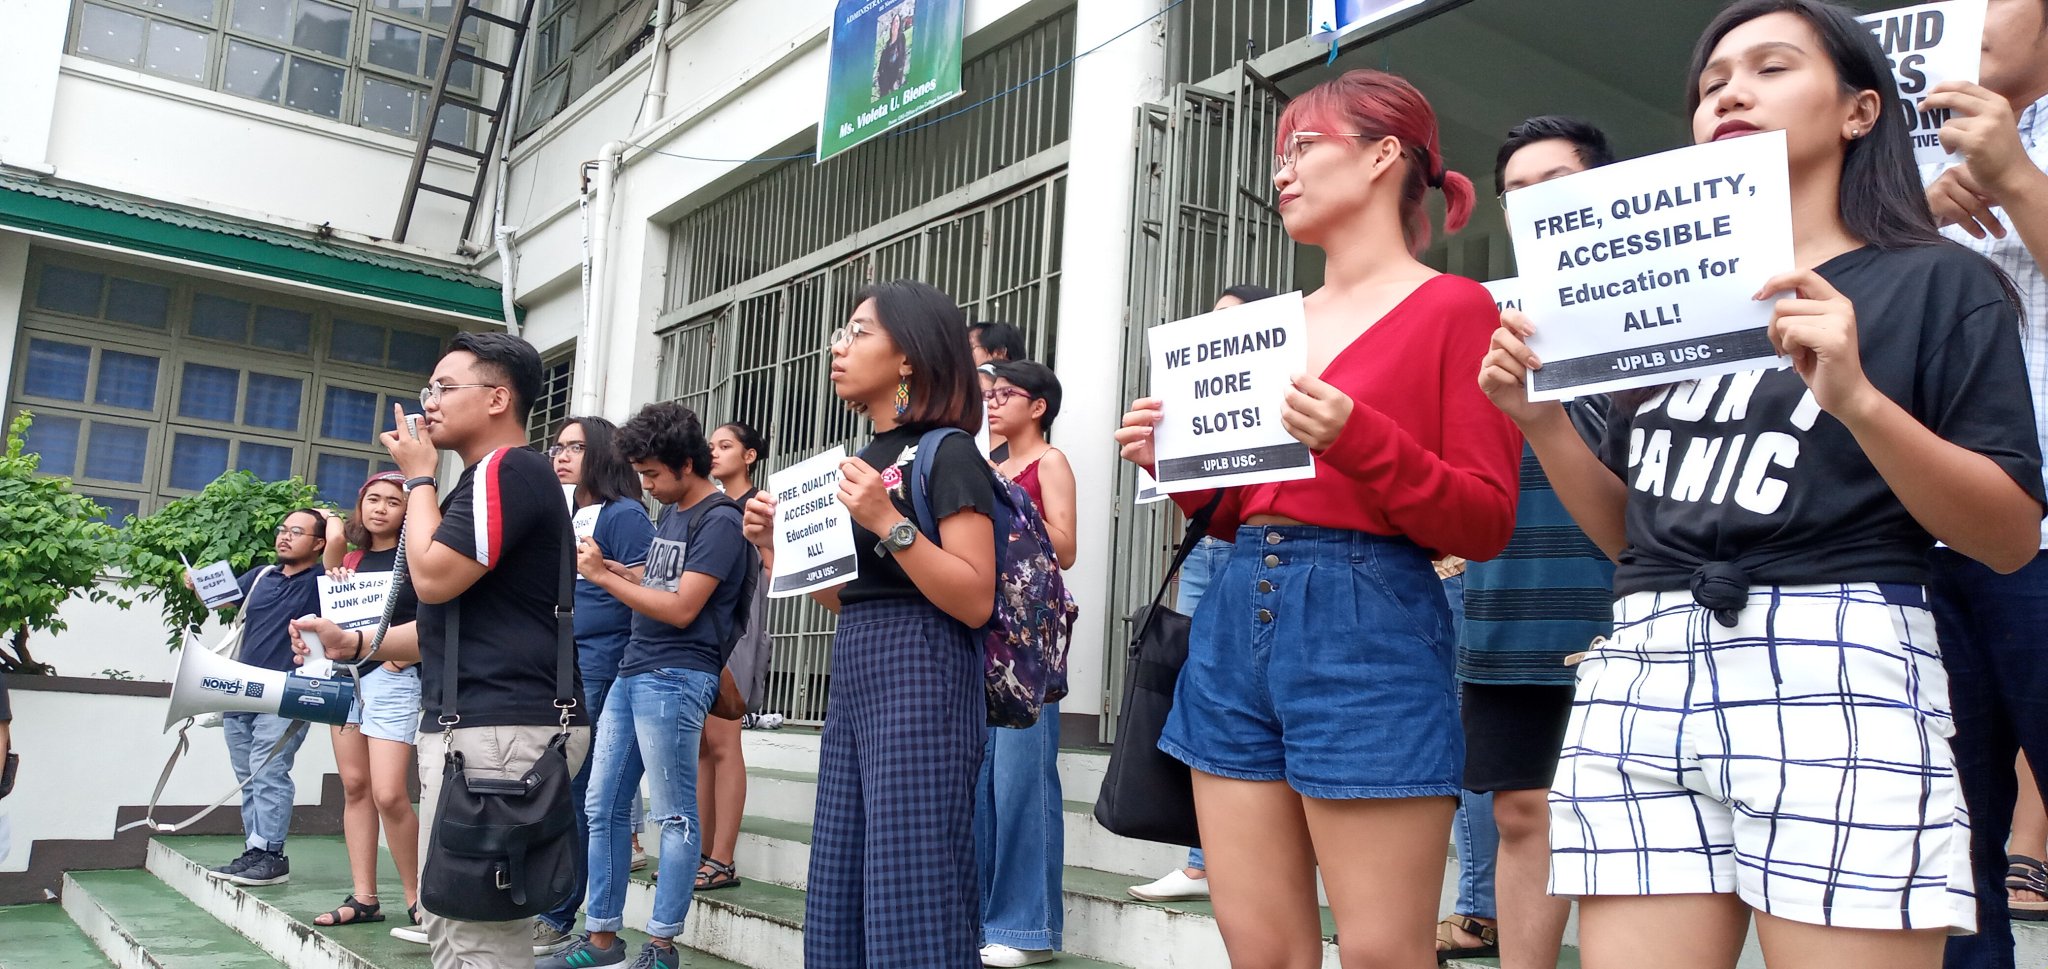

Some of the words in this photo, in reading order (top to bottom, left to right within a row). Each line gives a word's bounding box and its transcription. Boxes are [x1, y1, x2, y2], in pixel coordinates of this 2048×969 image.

[839, 122, 855, 139] Ms.
[857, 104, 888, 129] Violeta
[890, 96, 900, 111] U.
[1534, 207, 1603, 240] FREE,
[1611, 173, 1756, 220] QUALITY,
[1557, 215, 1732, 271] ACCESSIBLE
[1558, 267, 1691, 307] Education
[1699, 257, 1740, 280] for
[1623, 303, 1682, 332] ALL!
[1165, 346, 1191, 370] WE
[1197, 327, 1287, 363] DEMAND
[1669, 344, 1711, 363] USC
[1194, 371, 1251, 399] MORE
[1192, 407, 1261, 436] SLOTS!
[1231, 454, 1257, 468] USC
[1628, 428, 1800, 515] PANIC
[778, 486, 800, 504] FREE,
[801, 470, 840, 494] QUALITY,
[784, 493, 835, 522] ACCESSIBLE
[786, 521, 824, 543] Education
[825, 516, 838, 529] for
[807, 542, 825, 558] ALL!
[822, 565, 835, 577] USC
[328, 582, 356, 595] JUNK
[331, 597, 359, 610] JUNK
[362, 593, 383, 605] eUP!
[202, 679, 243, 694] FANON
